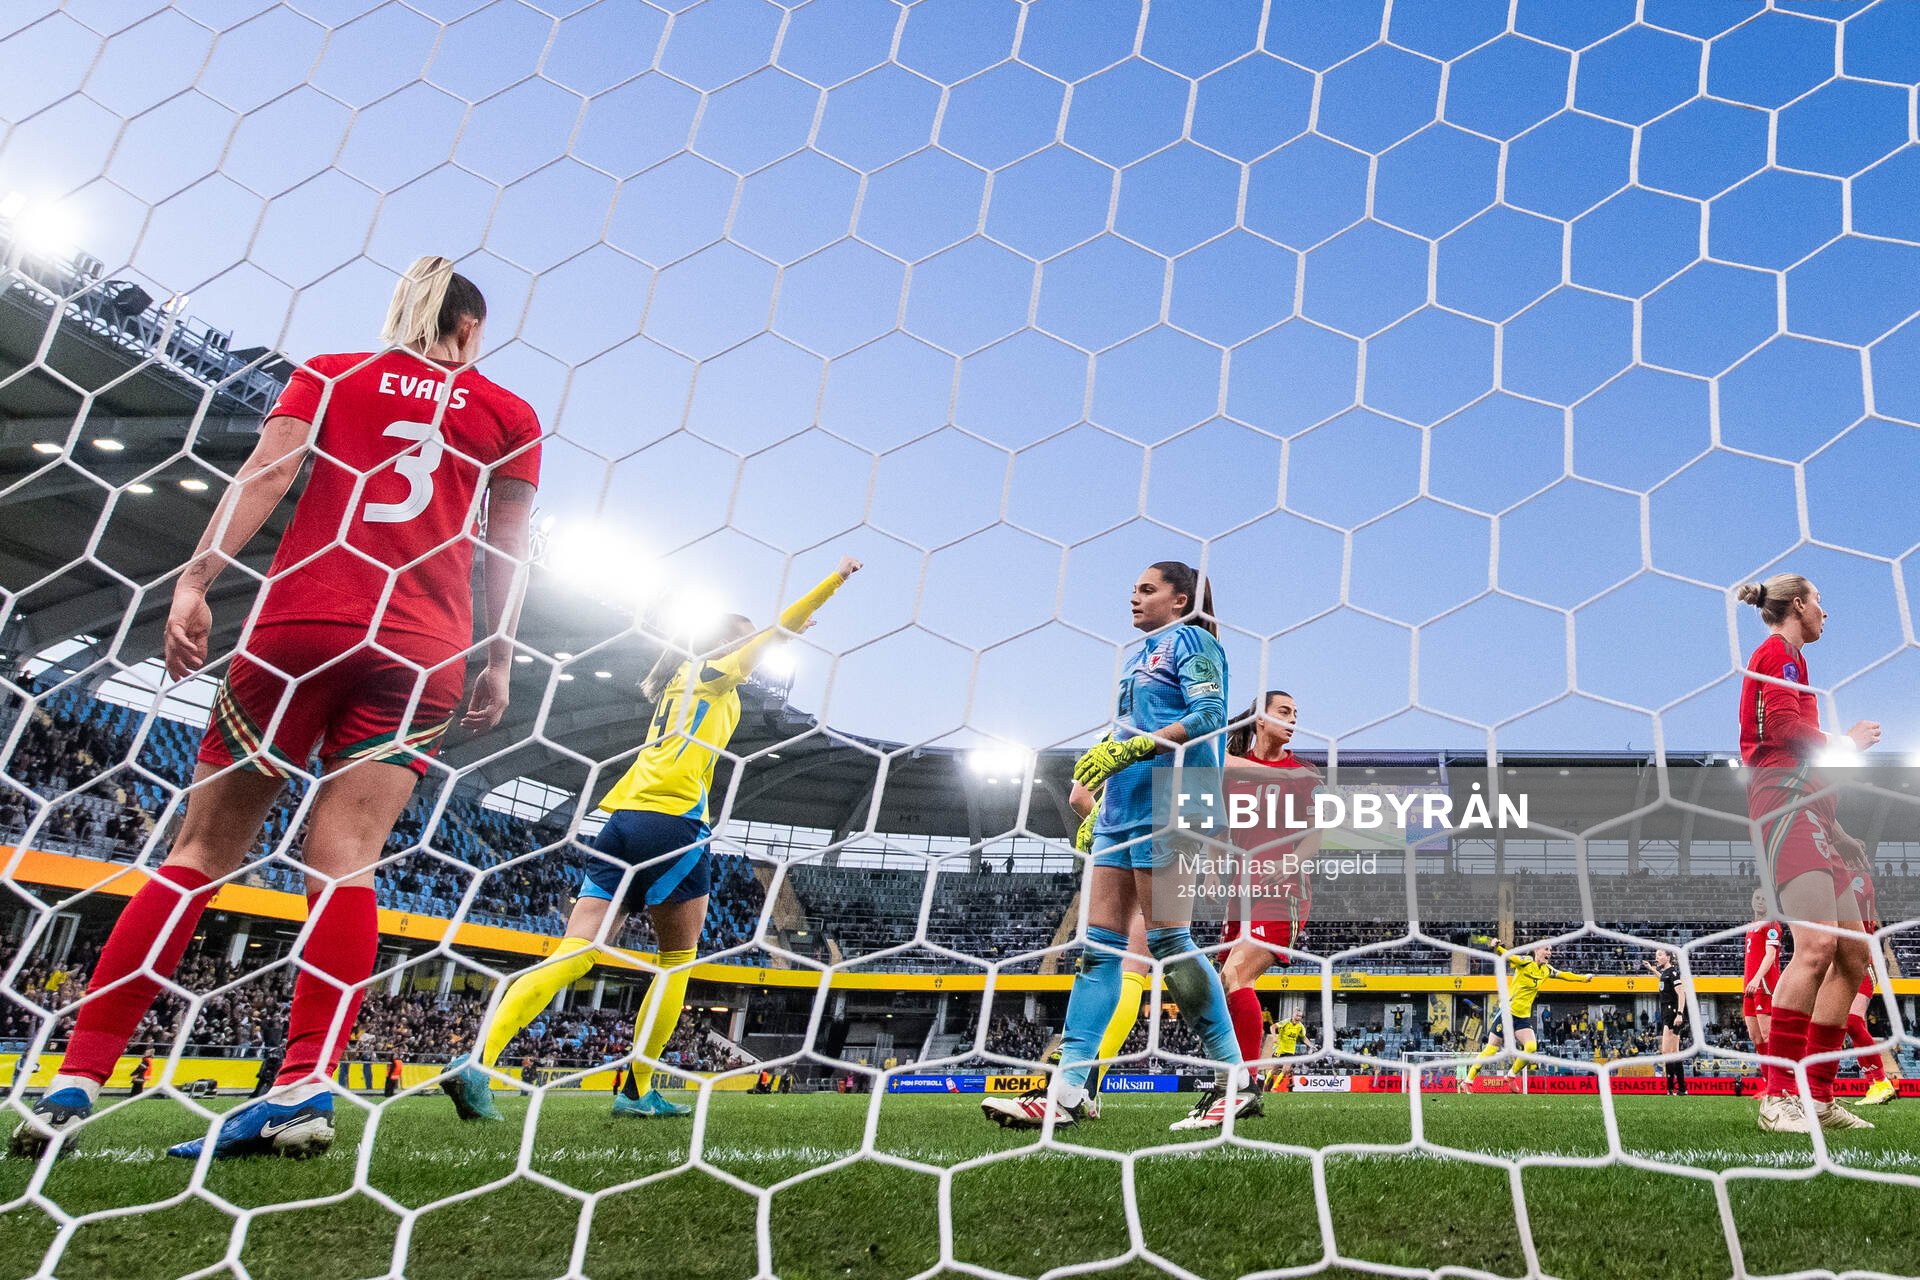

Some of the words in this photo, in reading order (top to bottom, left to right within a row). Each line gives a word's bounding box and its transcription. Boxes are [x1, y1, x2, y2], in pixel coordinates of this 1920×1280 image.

[363, 420, 445, 523] 3
[1106, 1078, 1155, 1090] Folksam
[1550, 1080, 1577, 1090] KOLL
[1580, 1077, 1593, 1090] PÅ
[1612, 1081, 1657, 1091] SENASTE
